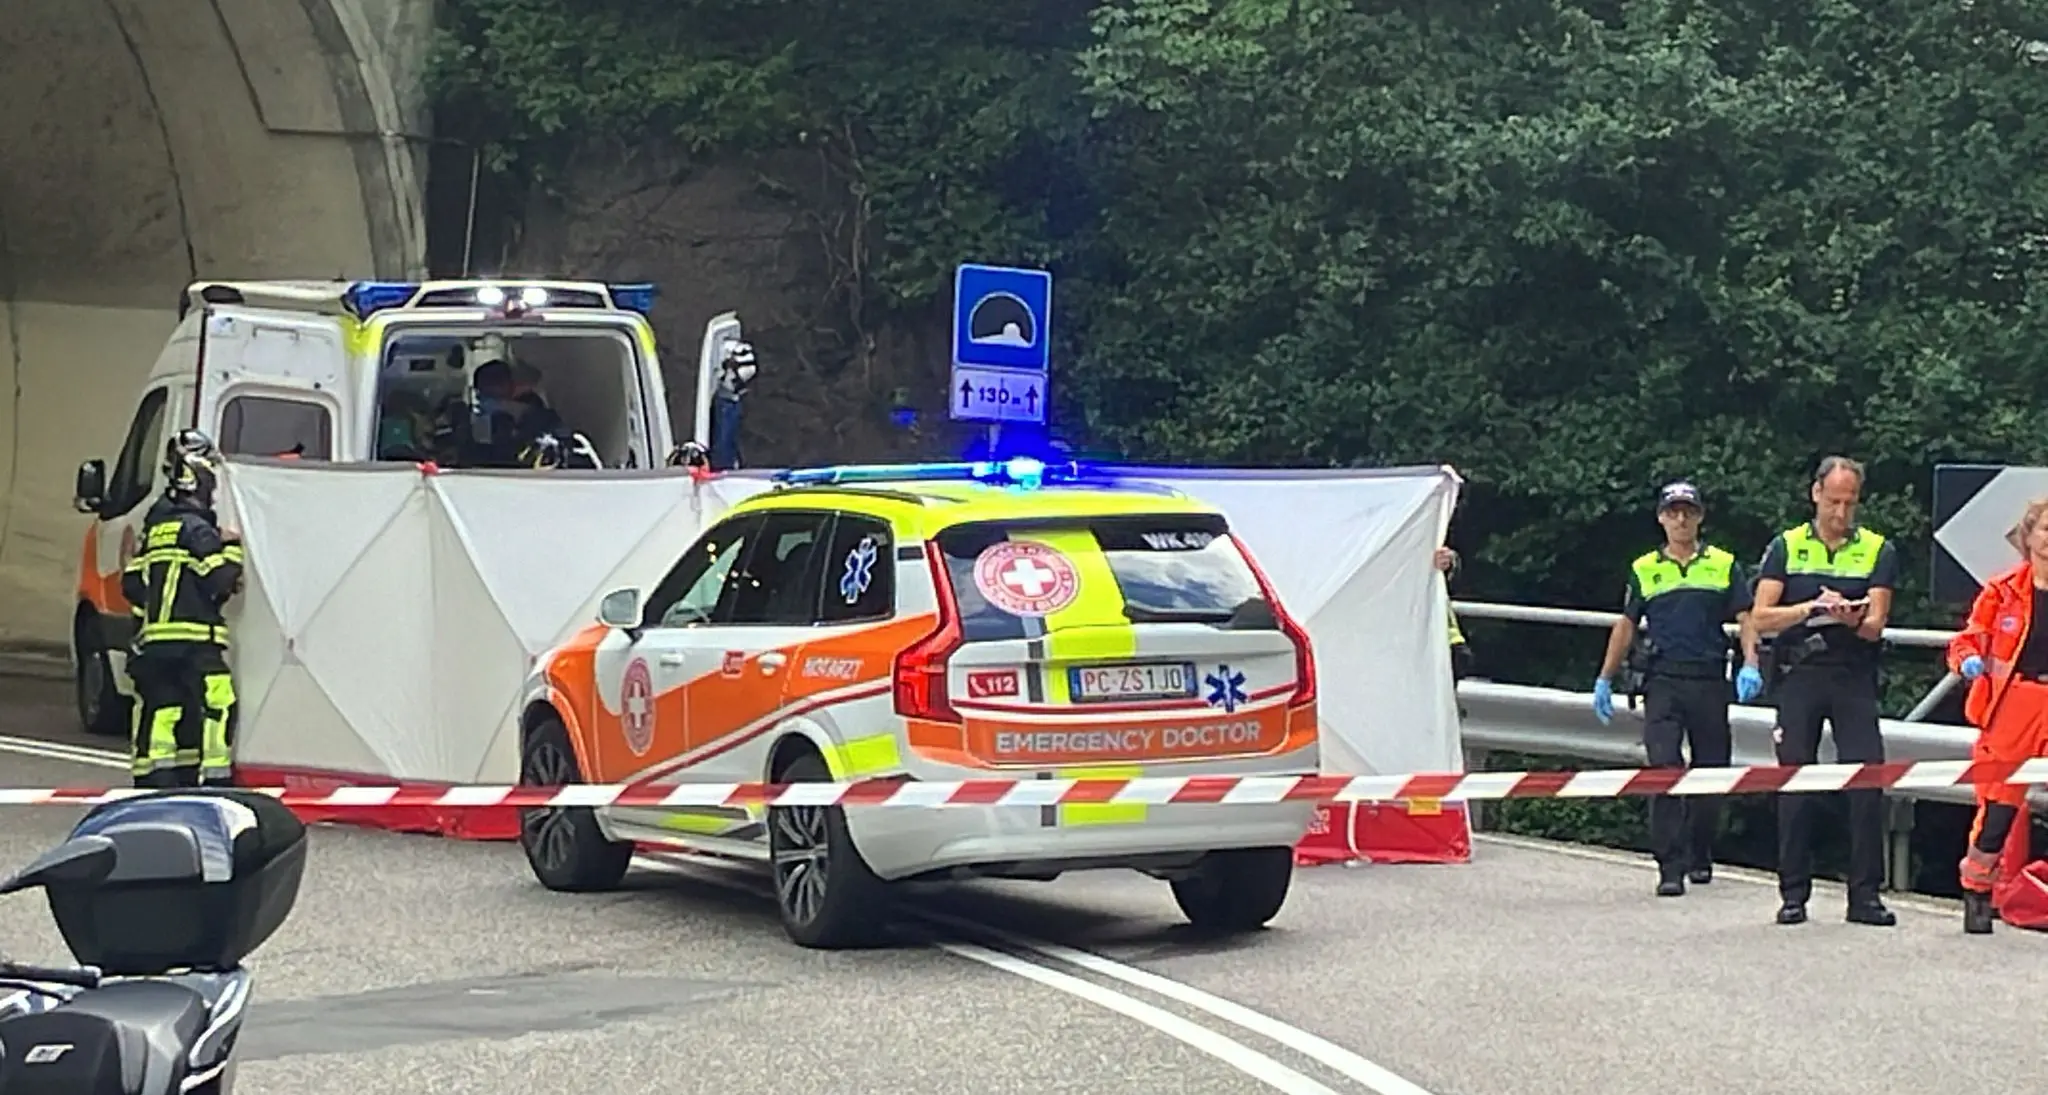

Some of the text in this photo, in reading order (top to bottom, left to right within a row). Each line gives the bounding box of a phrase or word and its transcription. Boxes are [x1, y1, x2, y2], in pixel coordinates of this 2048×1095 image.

[979, 387, 1010, 405] 130
[1140, 532, 1187, 549] WK
[986, 675, 1016, 693] 112
[995, 720, 1262, 753] EMERGENCY DOCTOR
